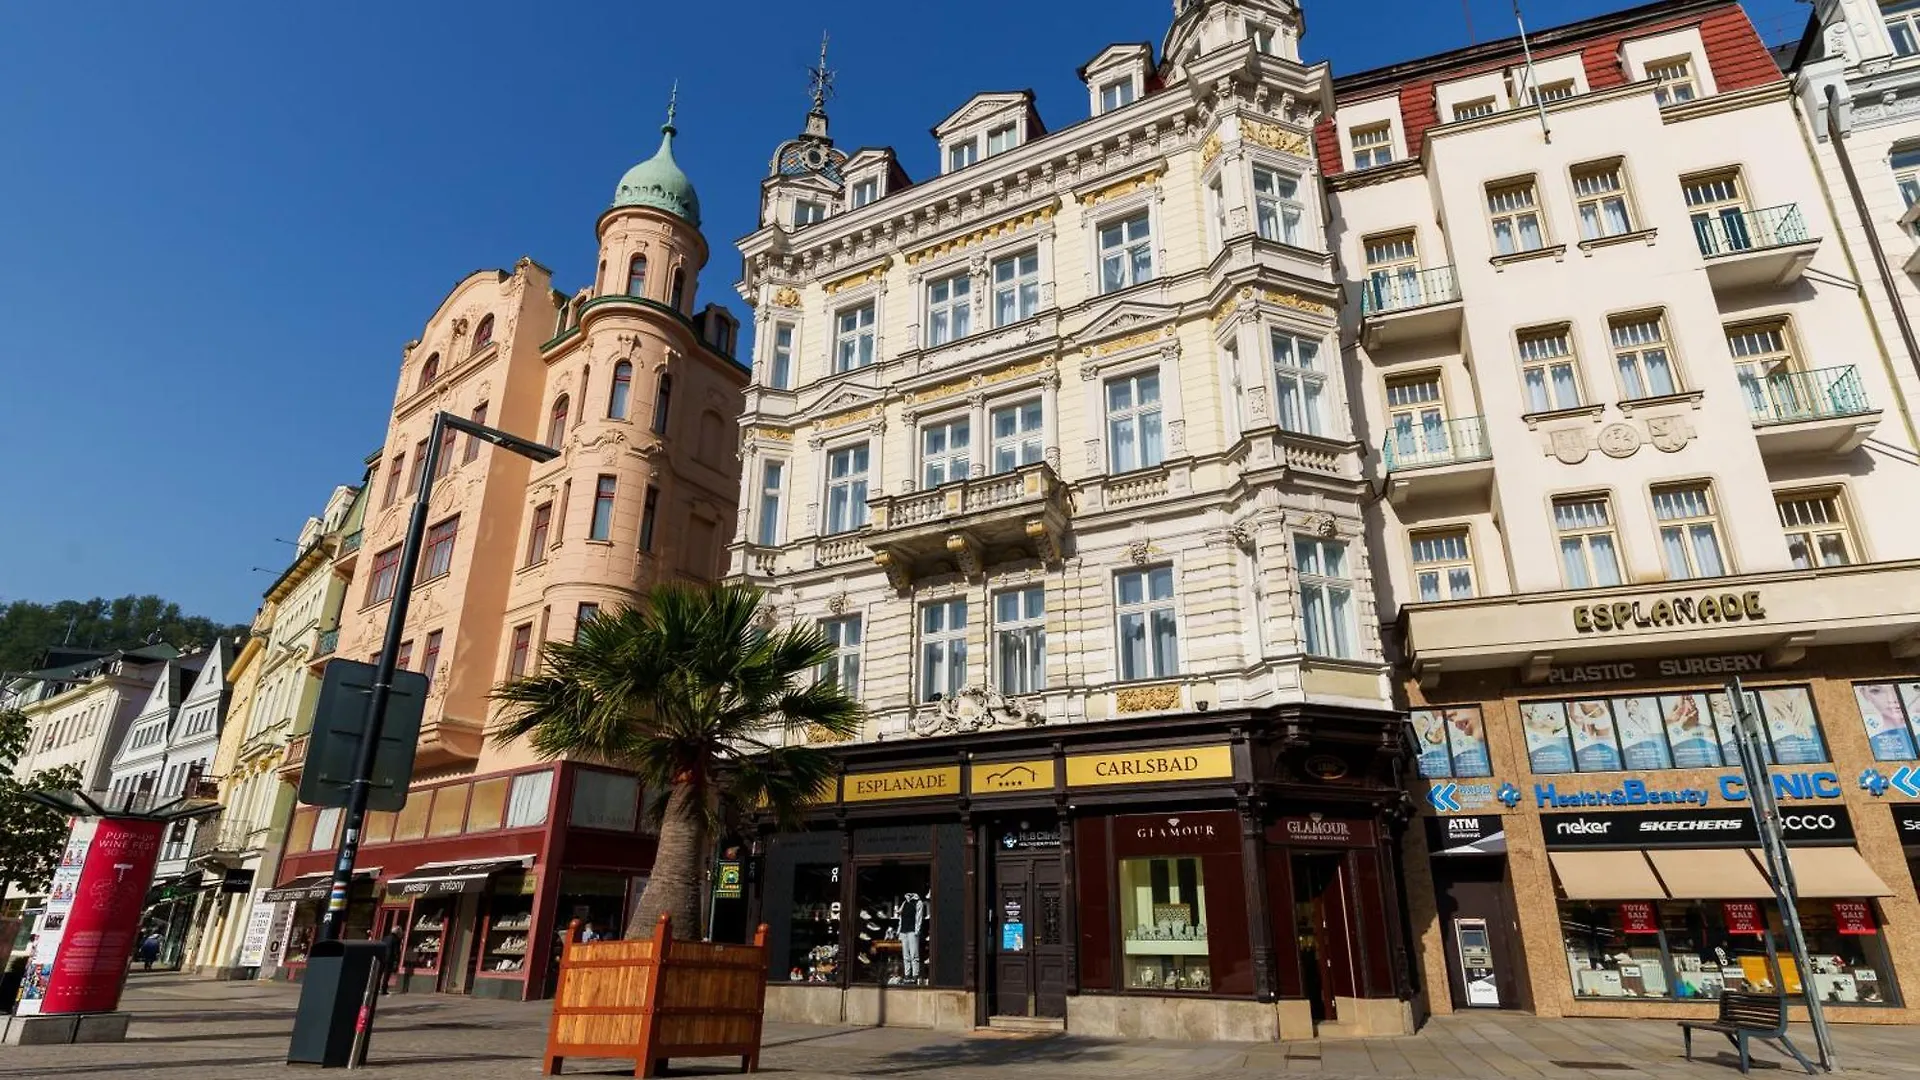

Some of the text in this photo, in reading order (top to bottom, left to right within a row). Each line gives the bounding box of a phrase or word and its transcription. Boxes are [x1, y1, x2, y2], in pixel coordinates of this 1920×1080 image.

[1573, 590, 1767, 634] ESPLANADE
[1548, 652, 1764, 685] PLASTIC SURGERY
[856, 756, 1198, 794] ESPLANADE CARLSBAD
[1719, 771, 1842, 802] CNIC
[1287, 821, 1351, 835] GLAMOUR
[1448, 818, 1479, 829] ATM
[1556, 817, 1612, 834] rieker
[1639, 819, 1743, 832] SKECHERS
[1137, 824, 1216, 838] GLAMOUR
[99, 840, 129, 849] WINE
[1622, 904, 1649, 912] TOTAL
[1726, 904, 1755, 912] TOTAL
[1835, 903, 1866, 912] TOTAL
